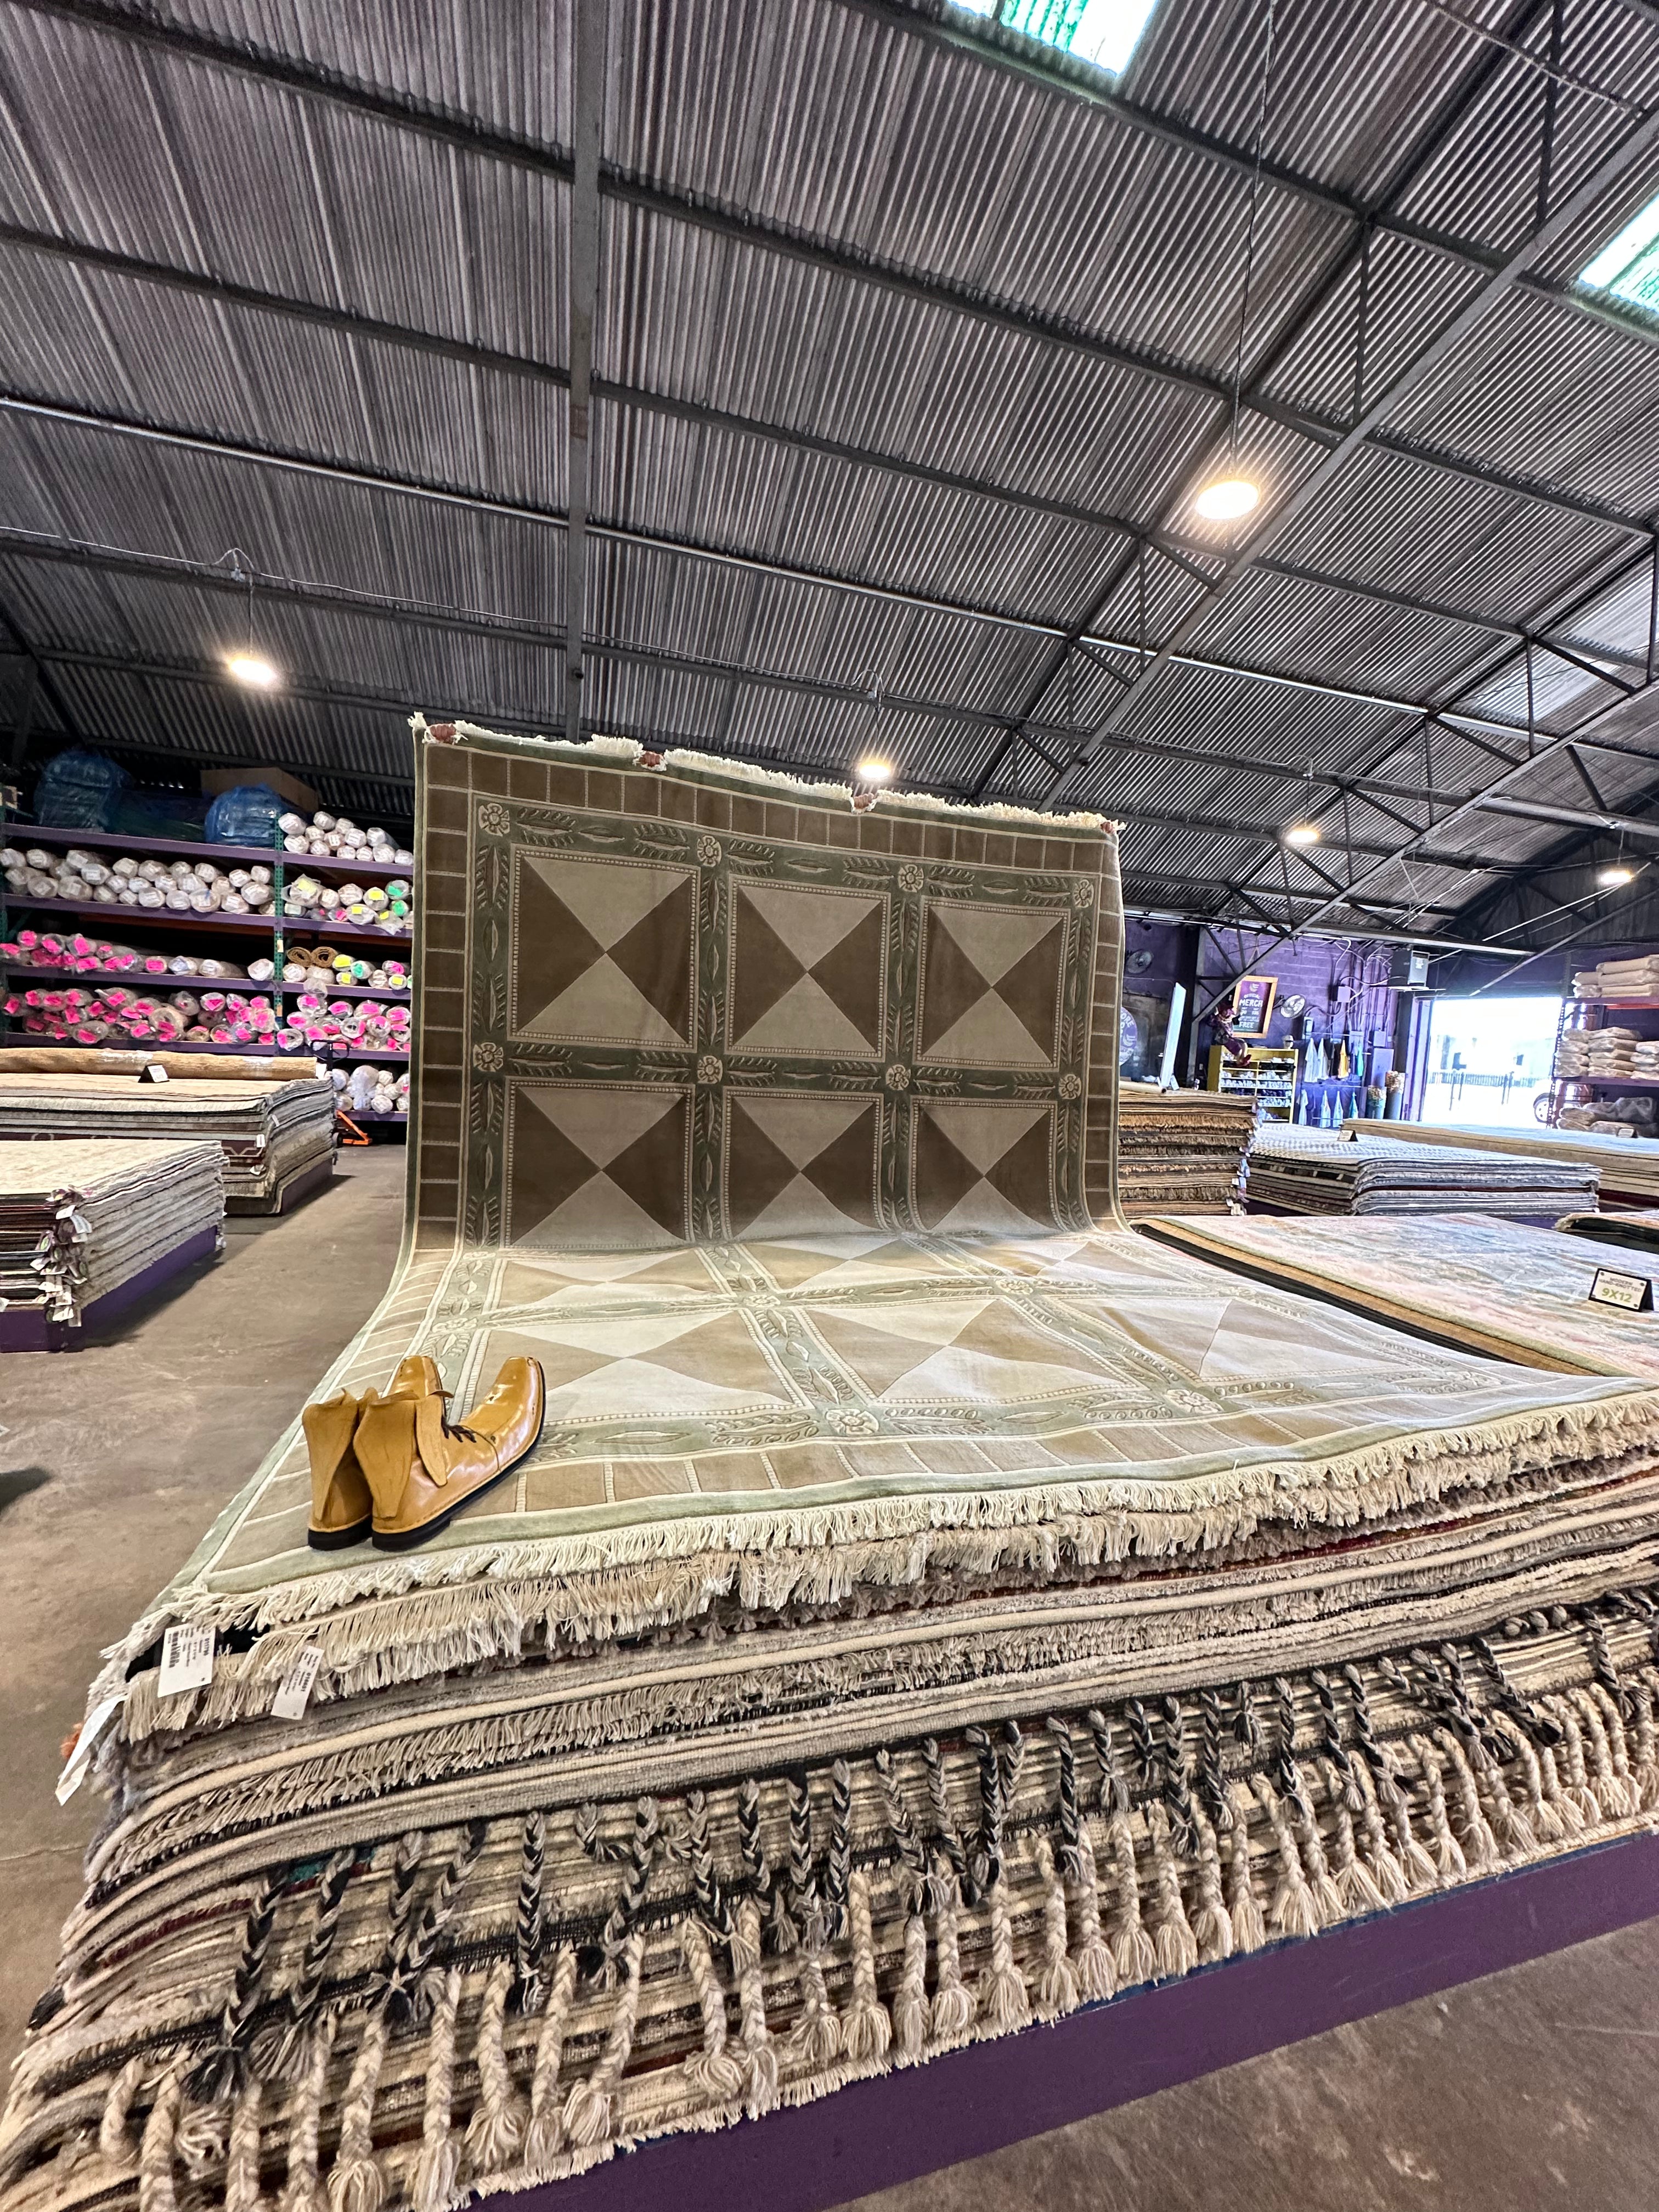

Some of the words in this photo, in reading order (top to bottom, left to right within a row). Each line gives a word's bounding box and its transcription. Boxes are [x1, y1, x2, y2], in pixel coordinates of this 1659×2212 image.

[1239, 999, 1263, 1007] MERCH
[1599, 1279, 1642, 1293] HAND-KNOTTED
[1610, 1277, 1633, 1285] MODERN
[1601, 1288, 1633, 1303] 9X12
